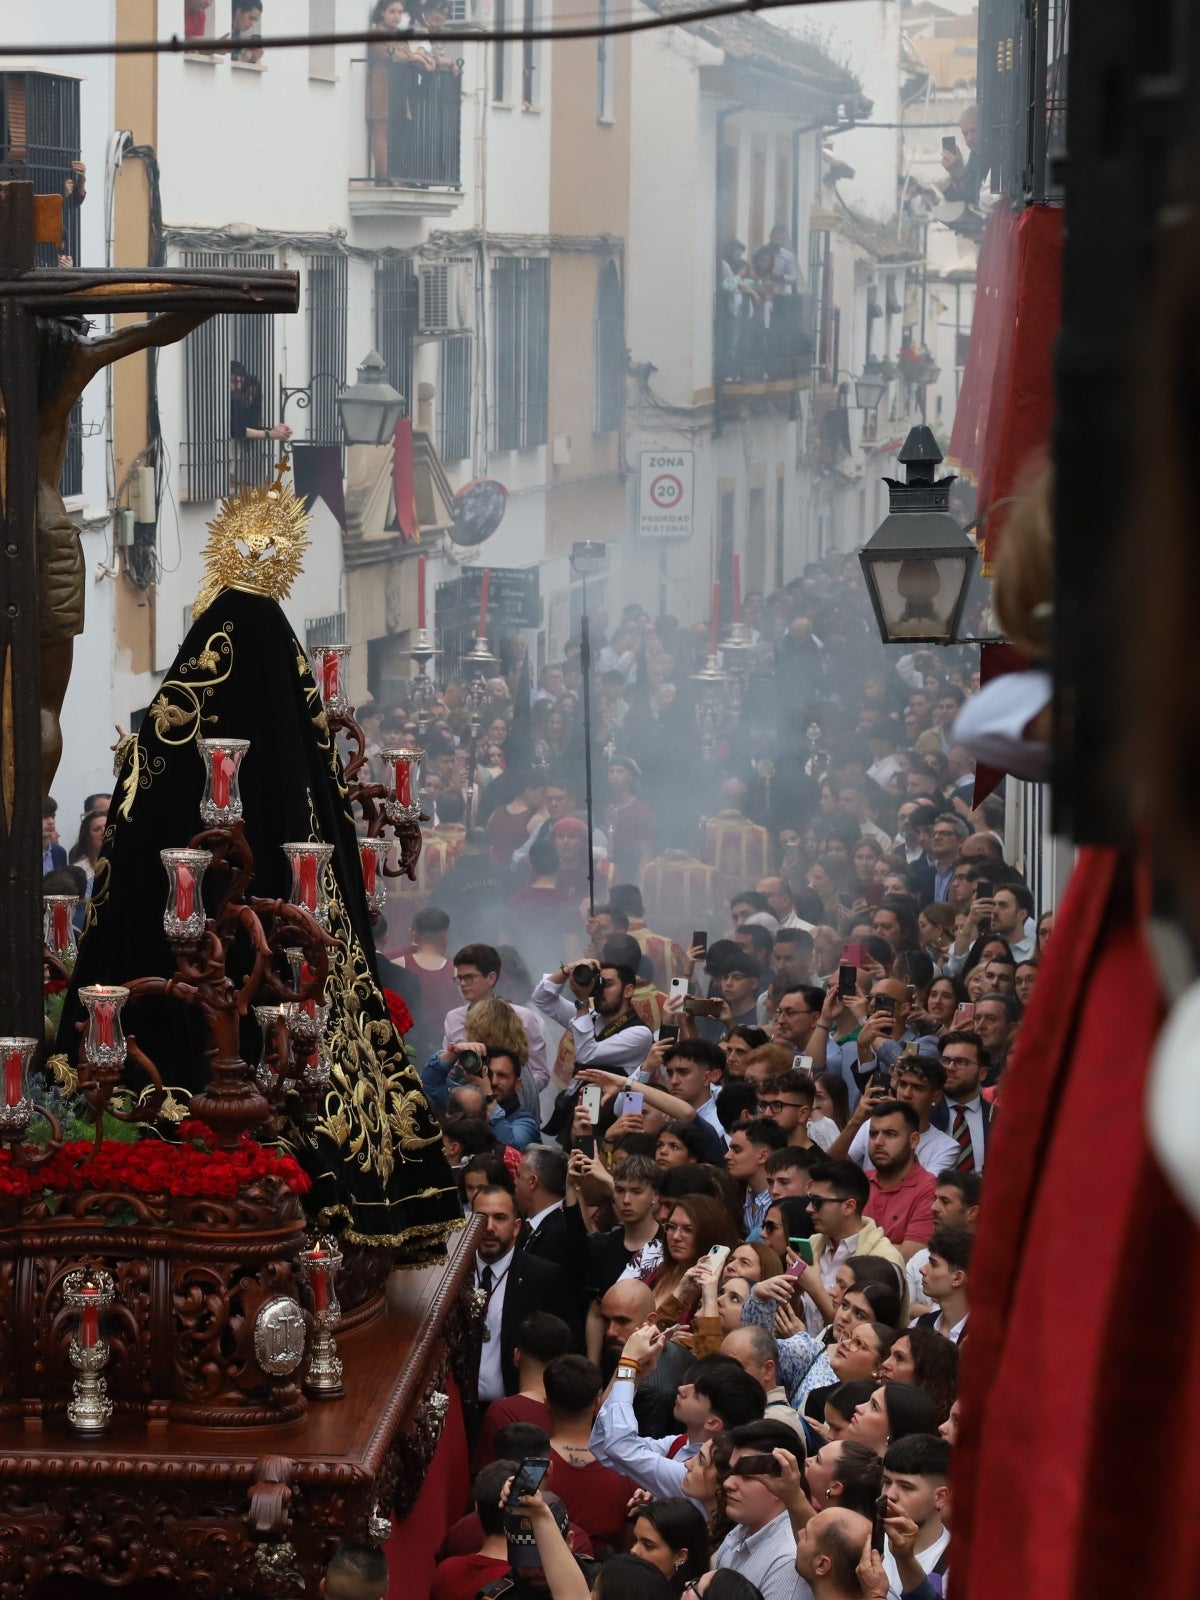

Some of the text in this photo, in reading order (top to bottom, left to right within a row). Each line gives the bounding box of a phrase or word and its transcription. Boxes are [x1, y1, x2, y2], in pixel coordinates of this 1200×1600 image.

[649, 457, 685, 467] ZONA
[658, 485, 676, 497] 20
[641, 515, 690, 523] PRIORIDAD
[641, 524, 690, 533] PEATONAL
